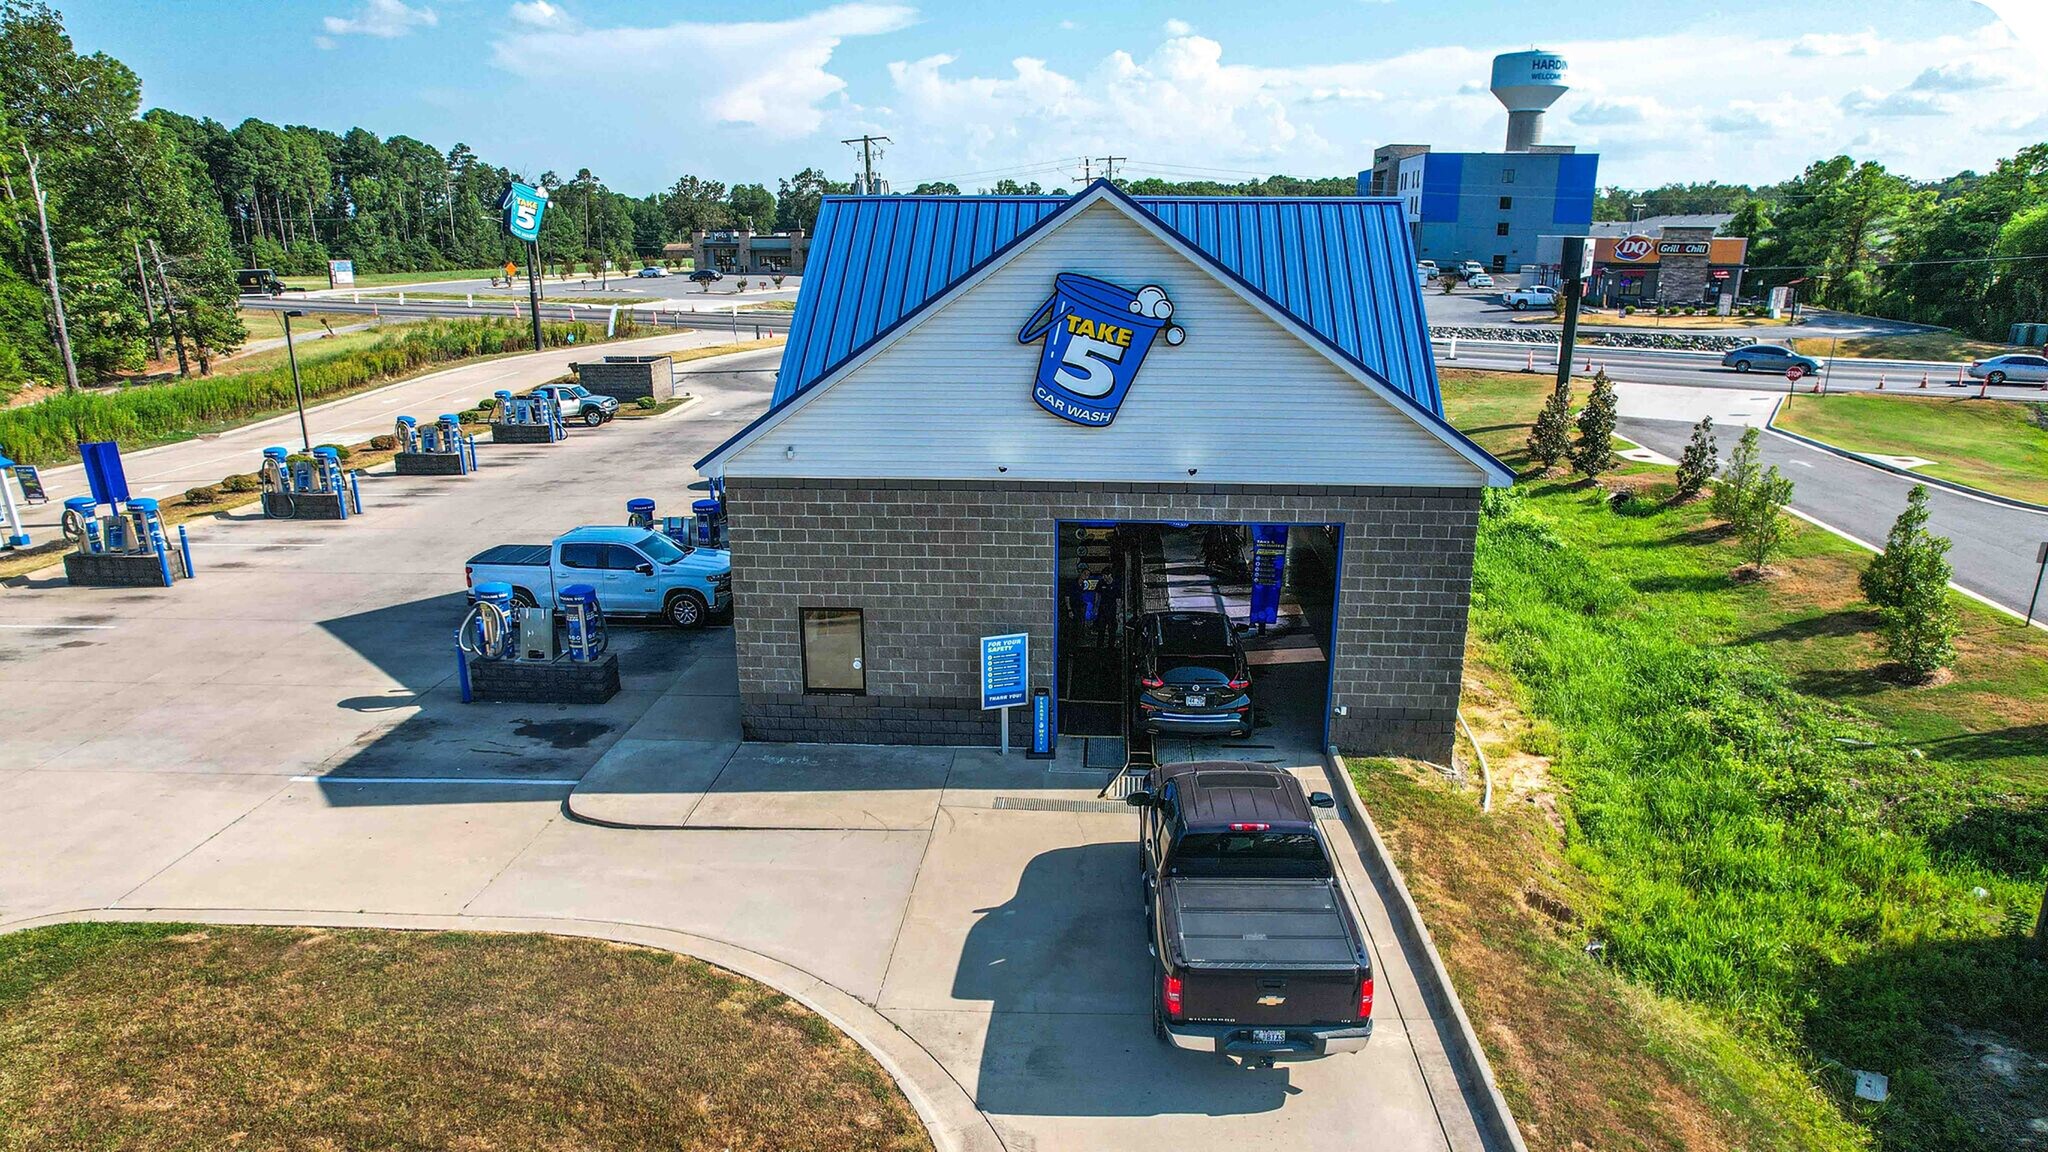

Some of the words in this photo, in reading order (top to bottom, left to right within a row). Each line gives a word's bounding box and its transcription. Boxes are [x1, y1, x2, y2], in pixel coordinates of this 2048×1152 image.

[517, 198, 538, 210] TAKE
[516, 206, 537, 229] 5
[1622, 240, 1647, 256] DQ
[1660, 244, 1679, 253] Grill
[1685, 244, 1706, 253] Chill
[1066, 314, 1133, 348] TAKE
[1053, 334, 1124, 398] 5
[1036, 387, 1065, 411] CAR
[1067, 404, 1112, 422] WASH
